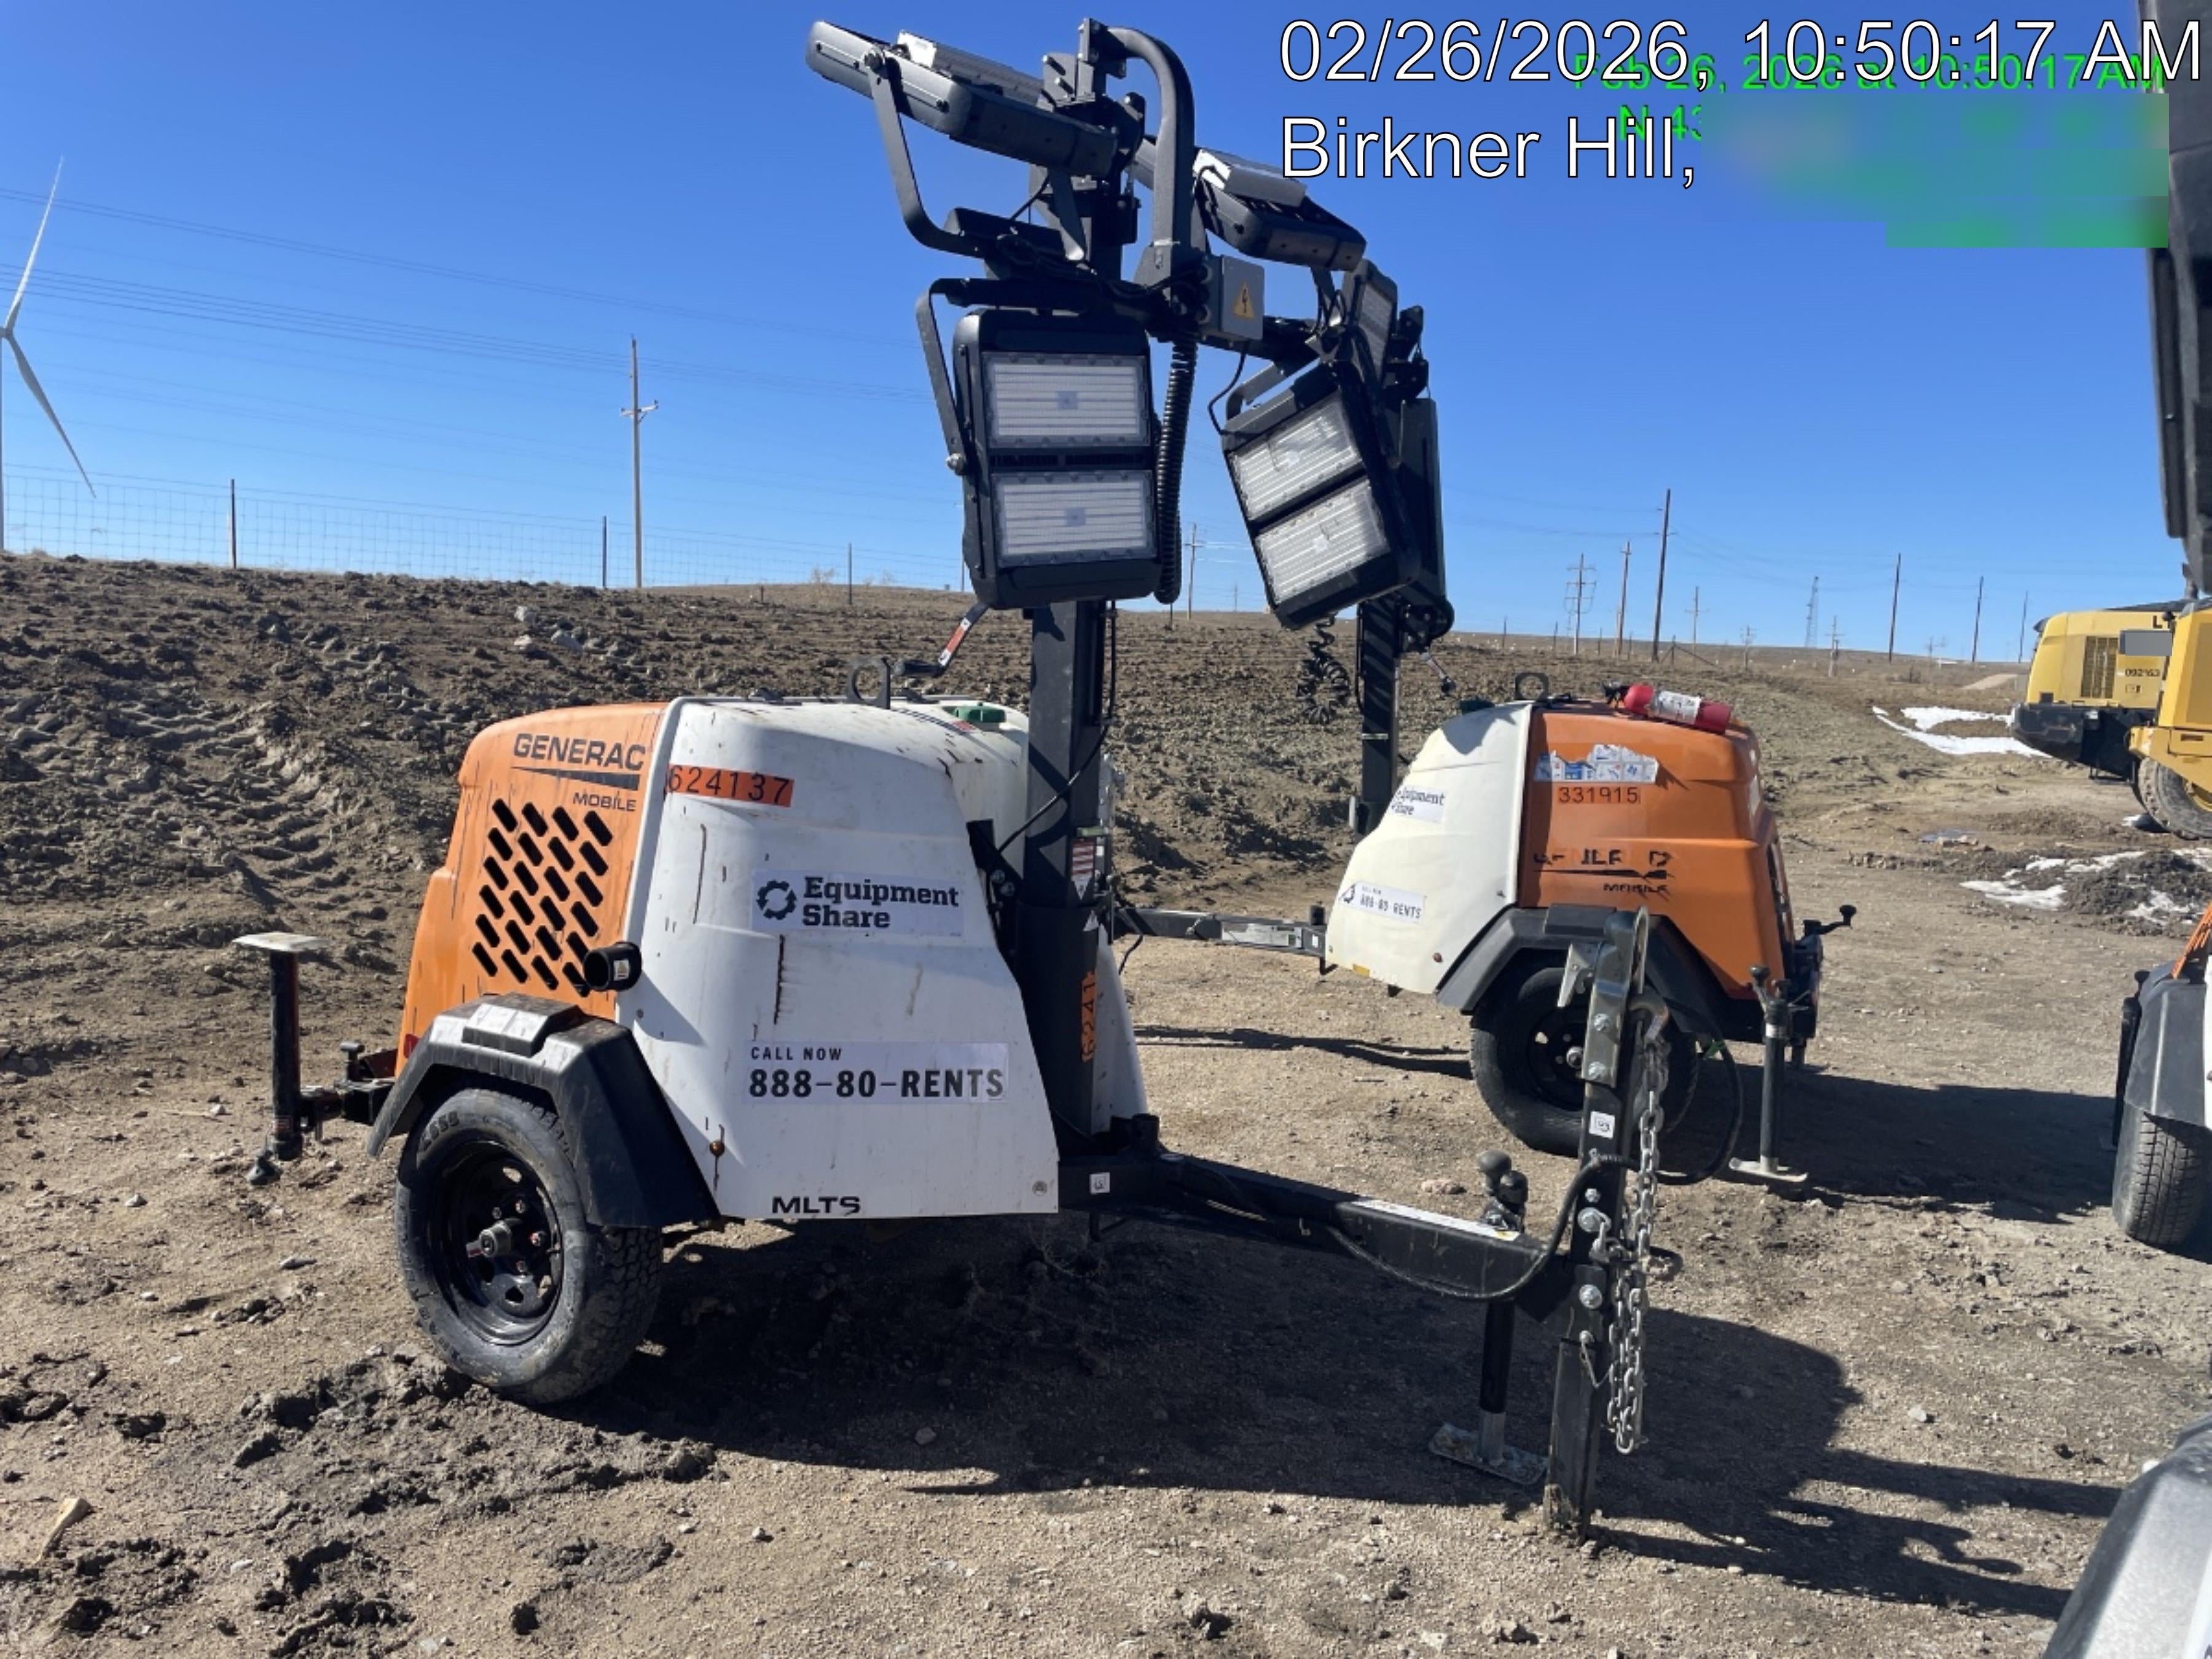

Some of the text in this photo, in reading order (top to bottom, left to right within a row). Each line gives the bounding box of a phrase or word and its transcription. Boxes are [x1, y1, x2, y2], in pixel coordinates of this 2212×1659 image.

[514, 733, 646, 771] GENERAC
[669, 765, 790, 805] 624137
[1558, 786, 1639, 804] 331915
[572, 791, 637, 812] MOBILE
[803, 876, 960, 908] Equipment
[802, 904, 890, 928] Share
[751, 1046, 842, 1061] CALL NOW
[749, 1069, 1004, 1098] 888-80-RENTS
[772, 1196, 860, 1215] MLTS
